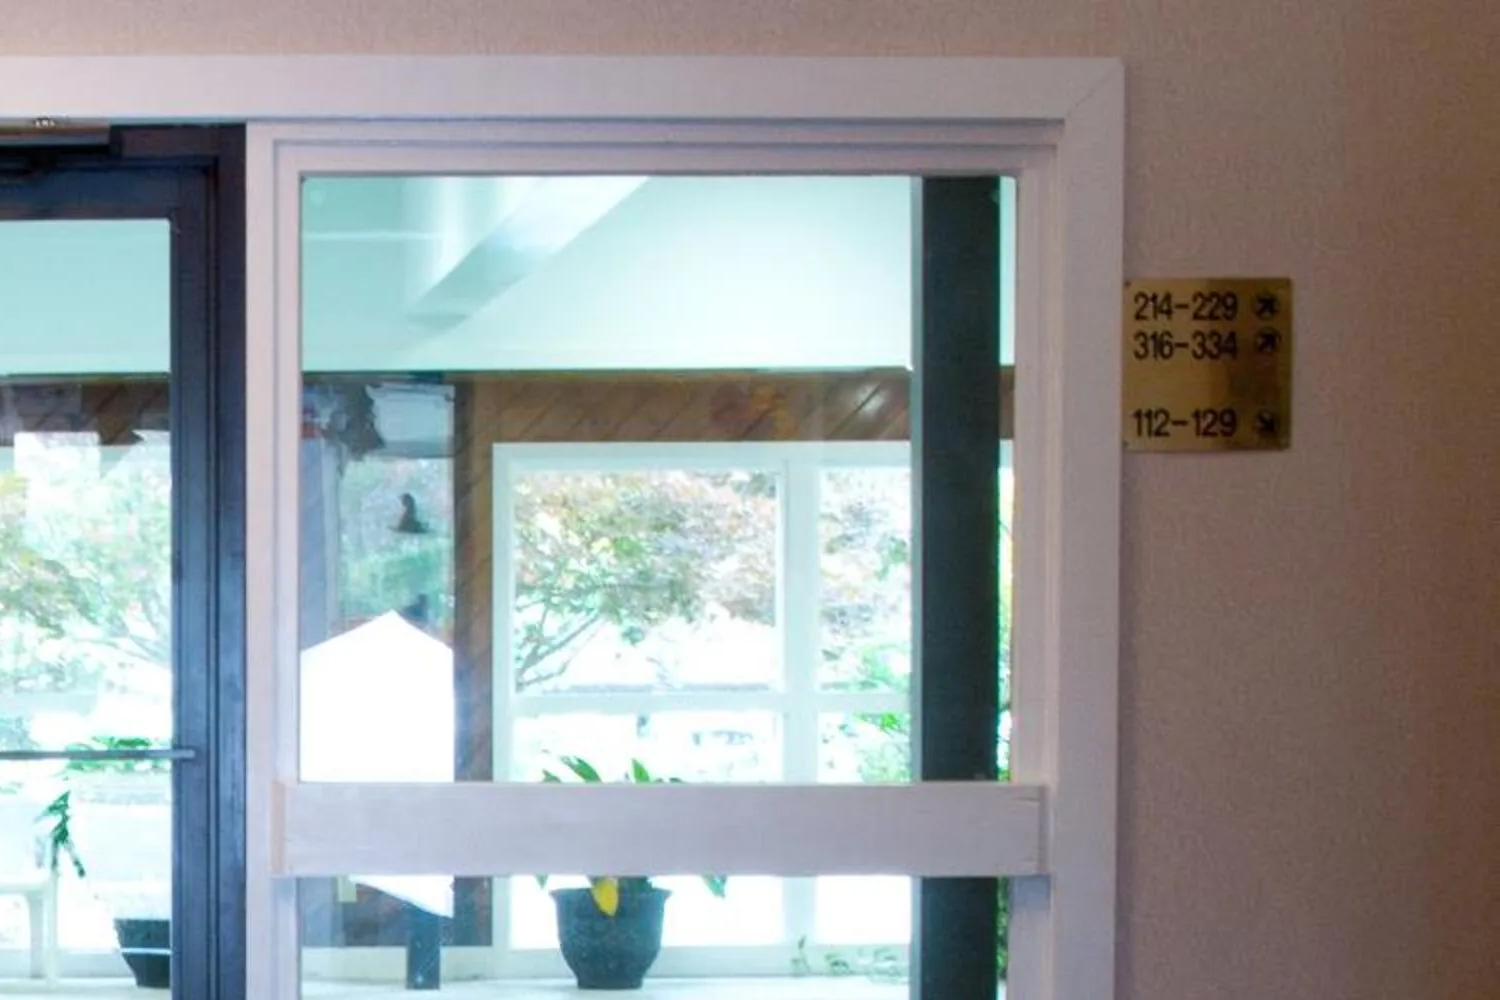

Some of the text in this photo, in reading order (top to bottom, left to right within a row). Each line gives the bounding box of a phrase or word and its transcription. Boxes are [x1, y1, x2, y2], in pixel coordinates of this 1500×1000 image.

[1133, 291, 1239, 321] 214-229
[1132, 330, 1239, 360] 316-334
[1132, 408, 1238, 438] 112-129
